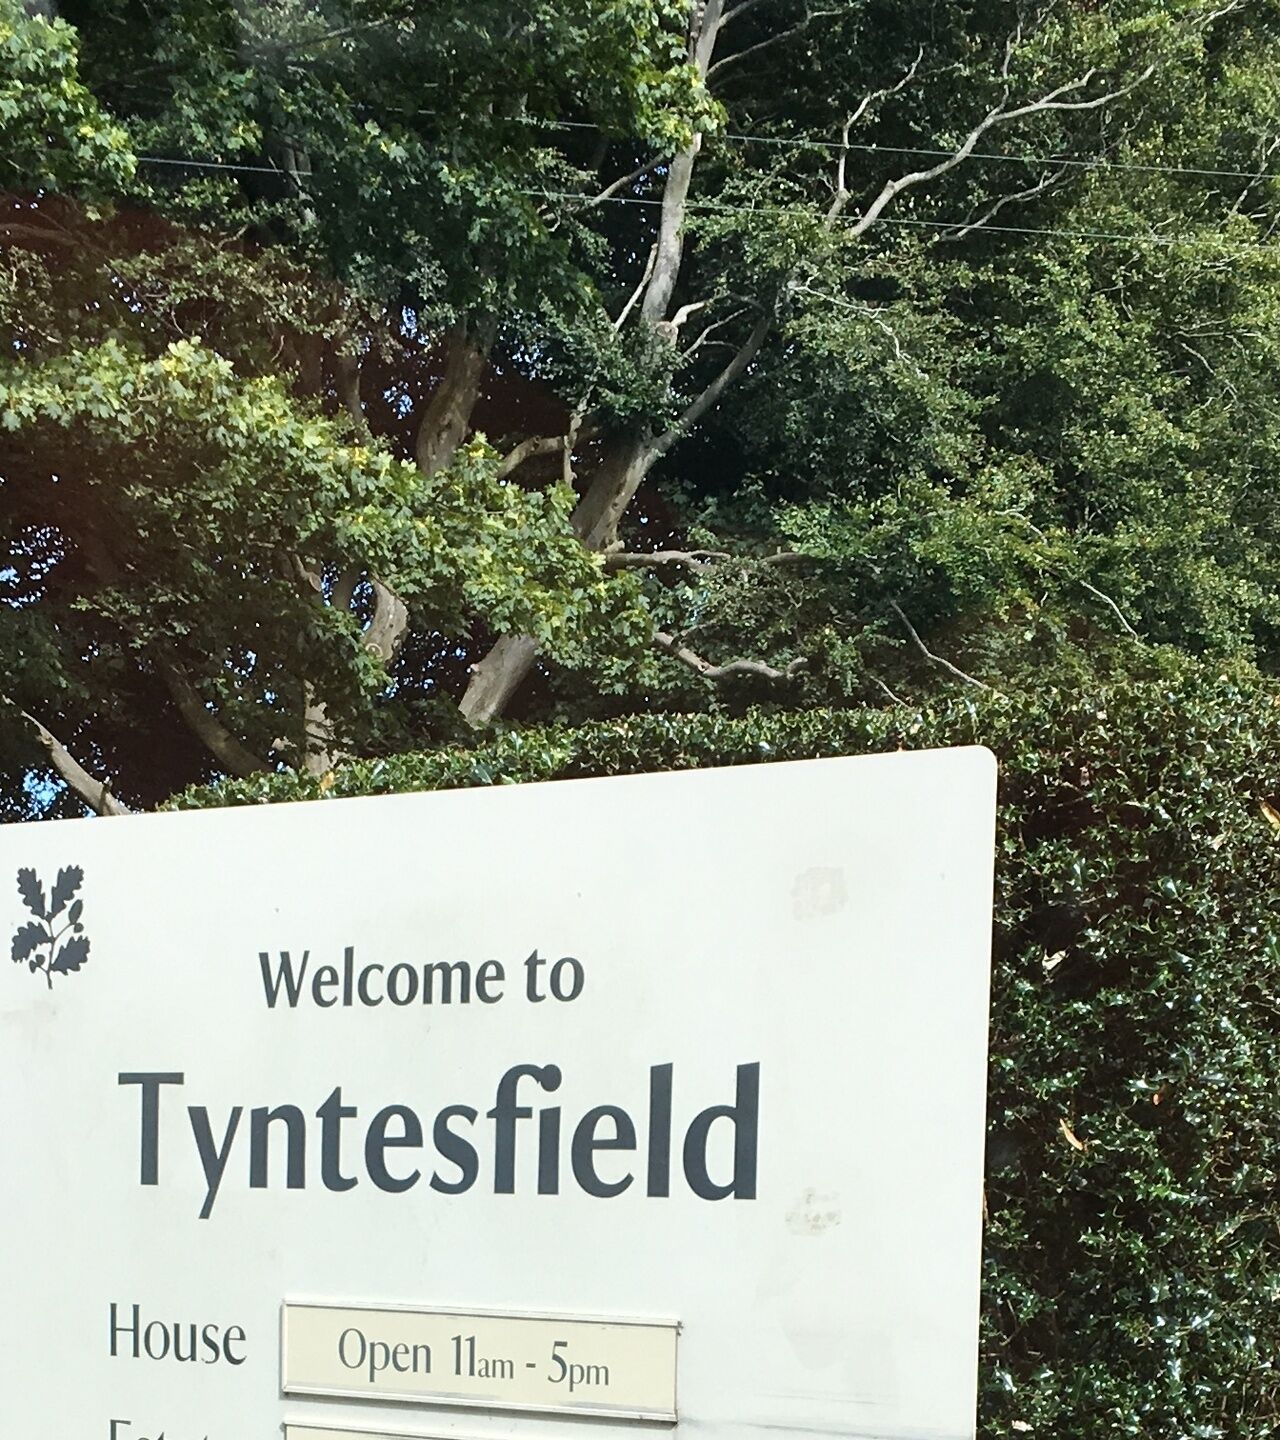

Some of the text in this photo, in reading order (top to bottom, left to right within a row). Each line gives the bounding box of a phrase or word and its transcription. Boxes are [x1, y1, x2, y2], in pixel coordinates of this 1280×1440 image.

[258, 946, 586, 1009] Welcome to
[116, 1061, 761, 1220] Tyntesfield
[108, 1302, 247, 1367] House
[338, 1327, 432, 1383] Open
[451, 1334, 515, 1380] 11am
[546, 1340, 610, 1393] 5pm
